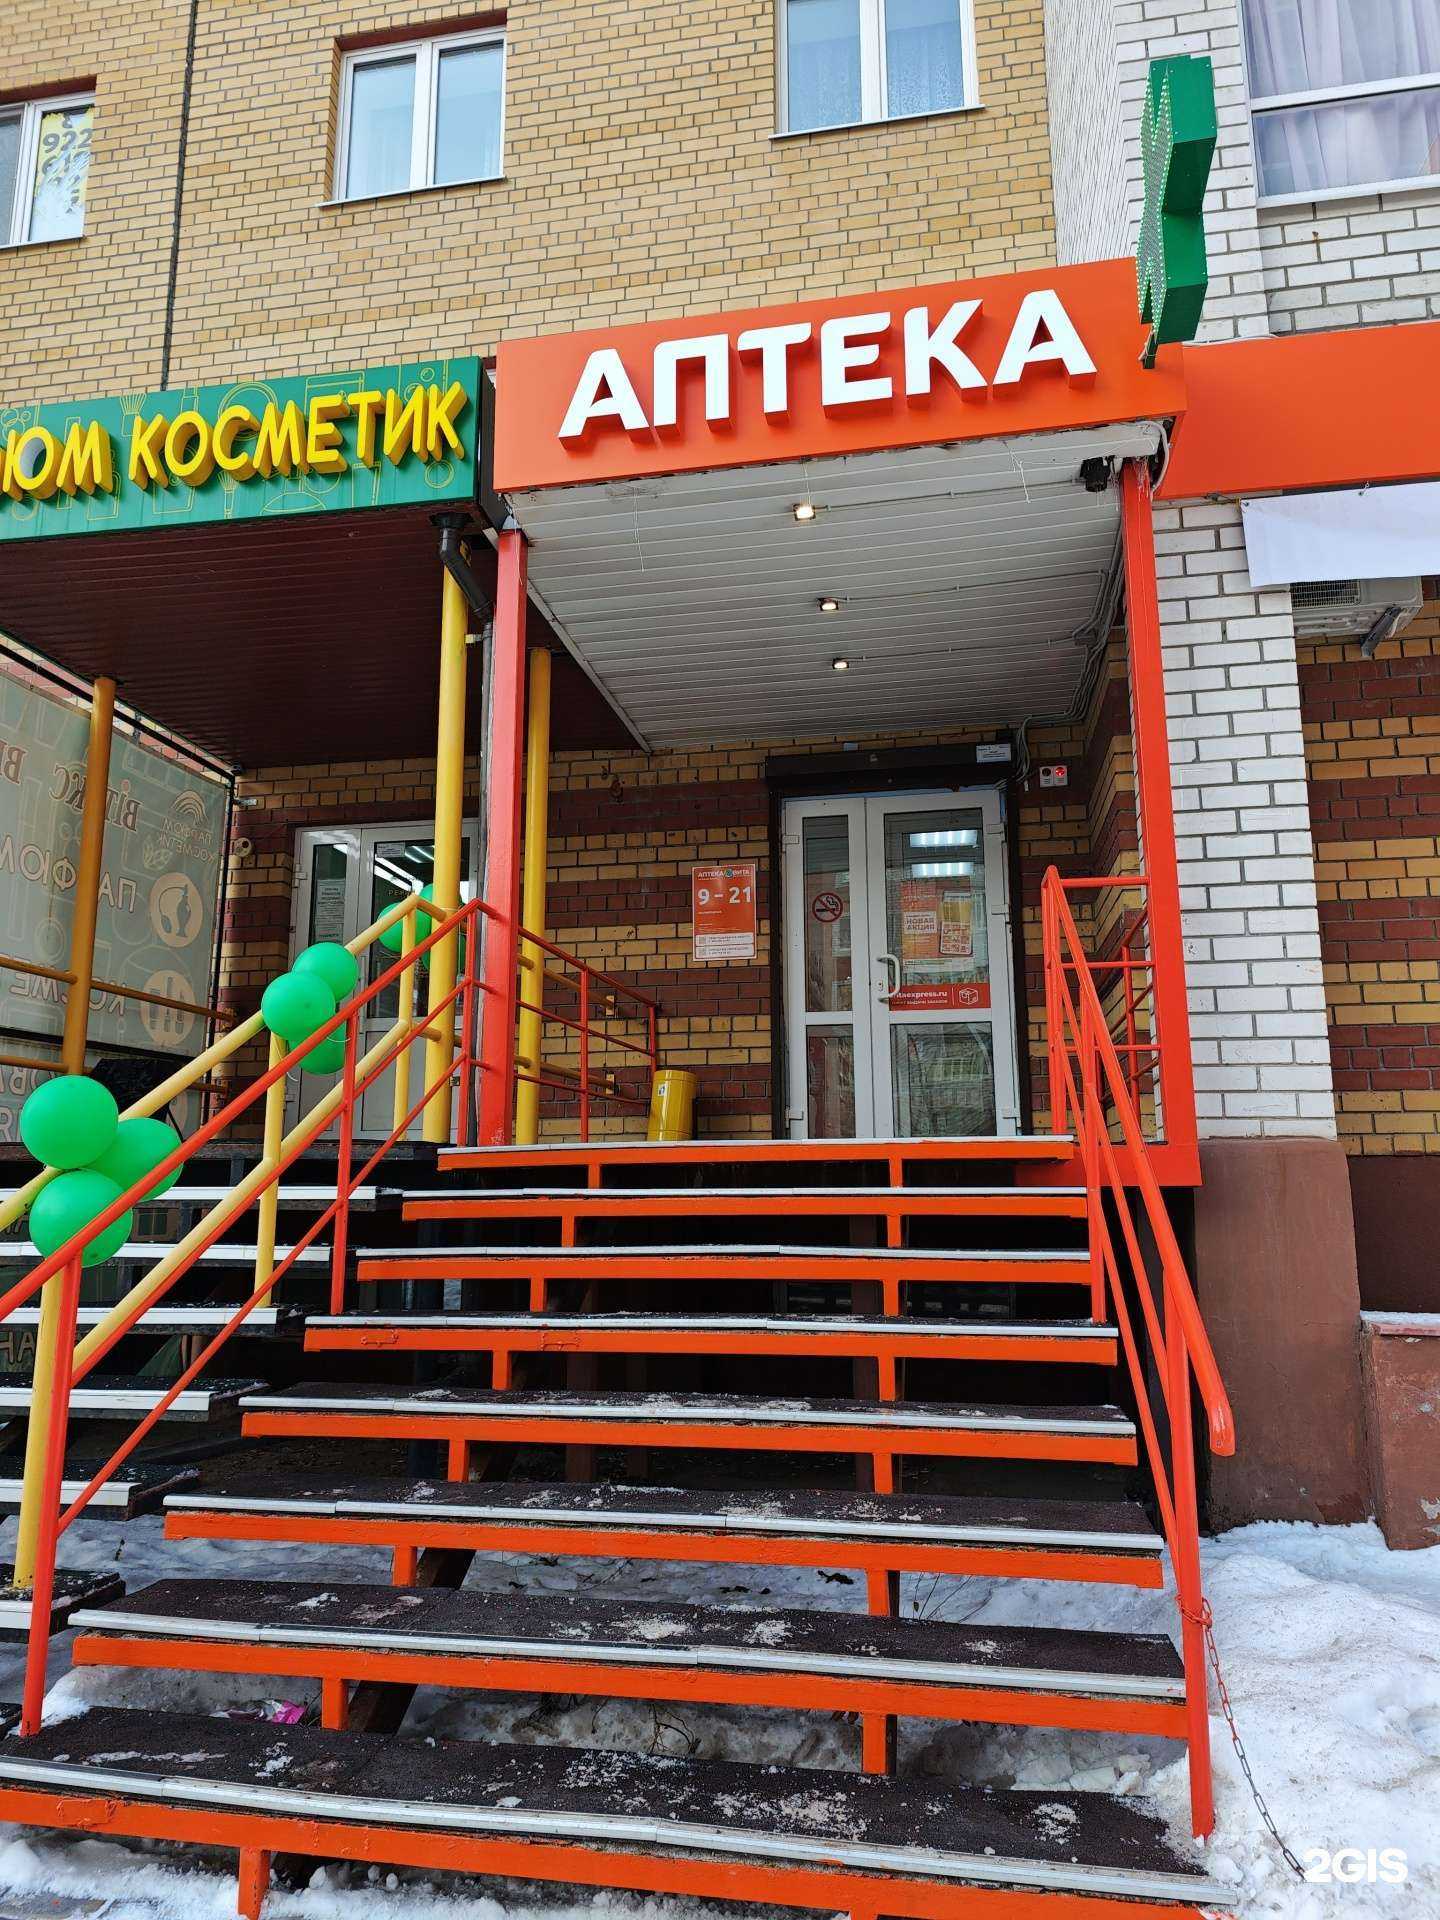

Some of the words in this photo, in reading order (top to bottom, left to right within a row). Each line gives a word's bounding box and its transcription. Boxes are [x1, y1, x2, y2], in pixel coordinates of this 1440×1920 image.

[558, 289, 1098, 439] АПТЕКА
[0, 420, 108, 497] ЮМ
[129, 381, 467, 487] КОСМЕТИК
[698, 869, 724, 878] АПТЕКА
[697, 888, 710, 905] 9
[728, 886, 752, 904] 21
[893, 991, 948, 999] itaexpress.ru
